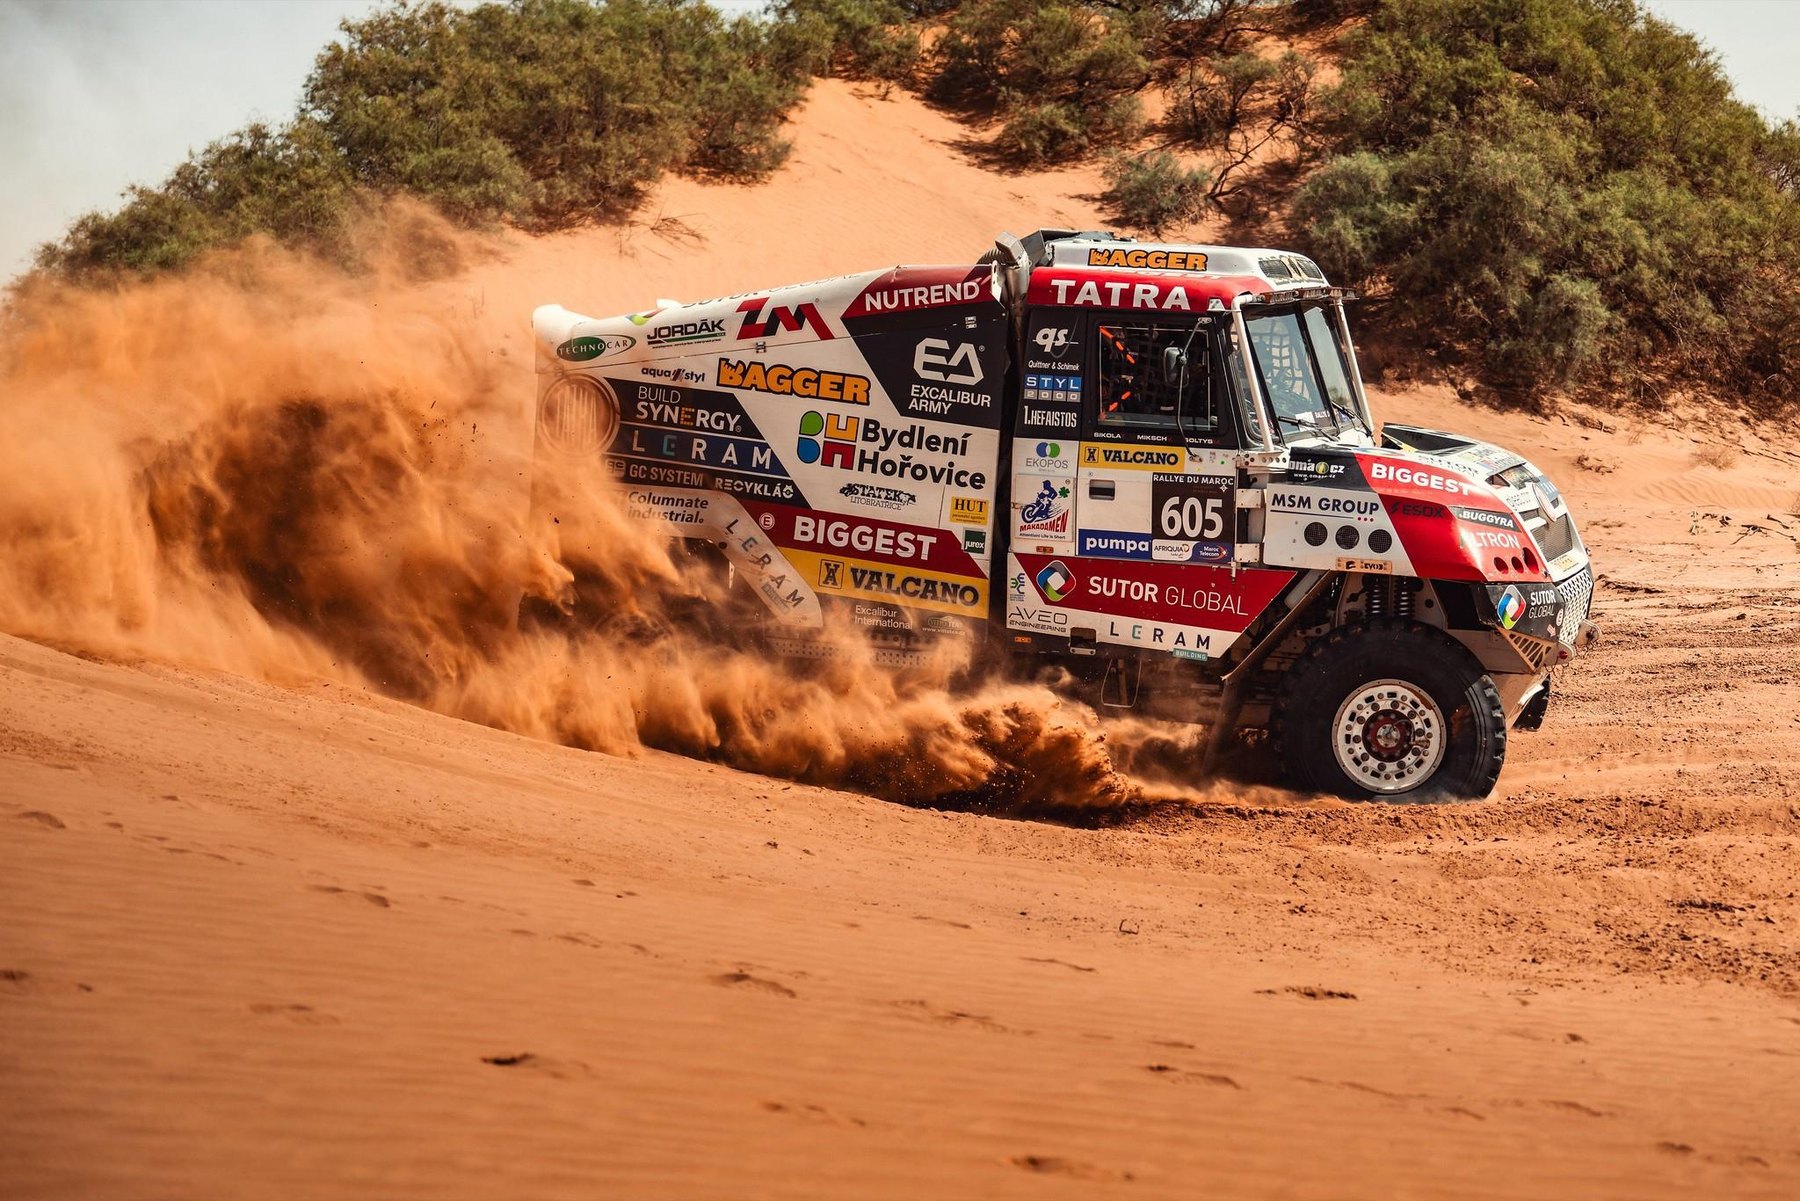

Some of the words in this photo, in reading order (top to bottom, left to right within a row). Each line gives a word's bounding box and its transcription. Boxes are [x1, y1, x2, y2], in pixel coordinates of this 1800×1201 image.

[1088, 248, 1208, 271] BAGGER
[865, 281, 980, 311] NUTREND
[1051, 279, 1191, 311] TATRA
[559, 339, 628, 355] TECHNOCAR
[641, 367, 671, 379] aqua
[684, 370, 705, 382] styl
[1028, 360, 1050, 369] Quittner
[1052, 362, 1056, 370] &
[1057, 362, 1079, 371] Schimek
[716, 357, 871, 406] BAGGER
[1026, 376, 1079, 389] STYL
[638, 385, 681, 404] BUILD
[910, 384, 991, 407] EXCALIBUR
[1026, 390, 1079, 400] 2000
[908, 398, 951, 415] ARMY
[636, 401, 738, 432] SYNERGY
[1024, 405, 1077, 428] 1.HEFAISTOS
[861, 418, 973, 457] Bydlení
[632, 430, 773, 470] LERAM
[1102, 449, 1179, 466] VALCANO
[857, 449, 986, 490] Hořovice
[1026, 458, 1068, 469] EKOPOS
[629, 464, 647, 479] GC
[650, 466, 704, 487] SYSTEM
[1153, 474, 1184, 483] RALLYE
[1187, 476, 1199, 484] DU
[1201, 476, 1234, 485] MAROC
[1371, 463, 1472, 496] BIGGEST
[628, 491, 709, 509] Columnate
[954, 498, 987, 513] HUT
[1271, 493, 1312, 509] MSM
[1318, 497, 1379, 515] GROUP
[1161, 496, 1224, 539] 605
[1402, 503, 1444, 518] ESOX
[1463, 510, 1514, 528] BUGGYRA
[1019, 509, 1069, 533] MAKADAMEN
[793, 515, 937, 560] BIGGEST
[965, 540, 984, 550] jurex
[1086, 537, 1149, 553] pumpa
[1153, 545, 1183, 553] AFRIQUIA
[1199, 550, 1219, 558] Telecom
[726, 518, 805, 608] LERAM
[851, 567, 980, 607] VALCANO
[1088, 575, 1158, 603] SUTOR
[1165, 586, 1249, 616] GLOBAL
[1530, 589, 1556, 606] SUTOR
[855, 604, 898, 618] Excalibur
[1009, 606, 1068, 625] AVEO
[1528, 604, 1555, 619] GLOBAL
[854, 615, 913, 630] International
[1009, 620, 1067, 632] ENGINEERING
[1109, 621, 1210, 650] LERAM
[1175, 650, 1206, 660] BUILDING
